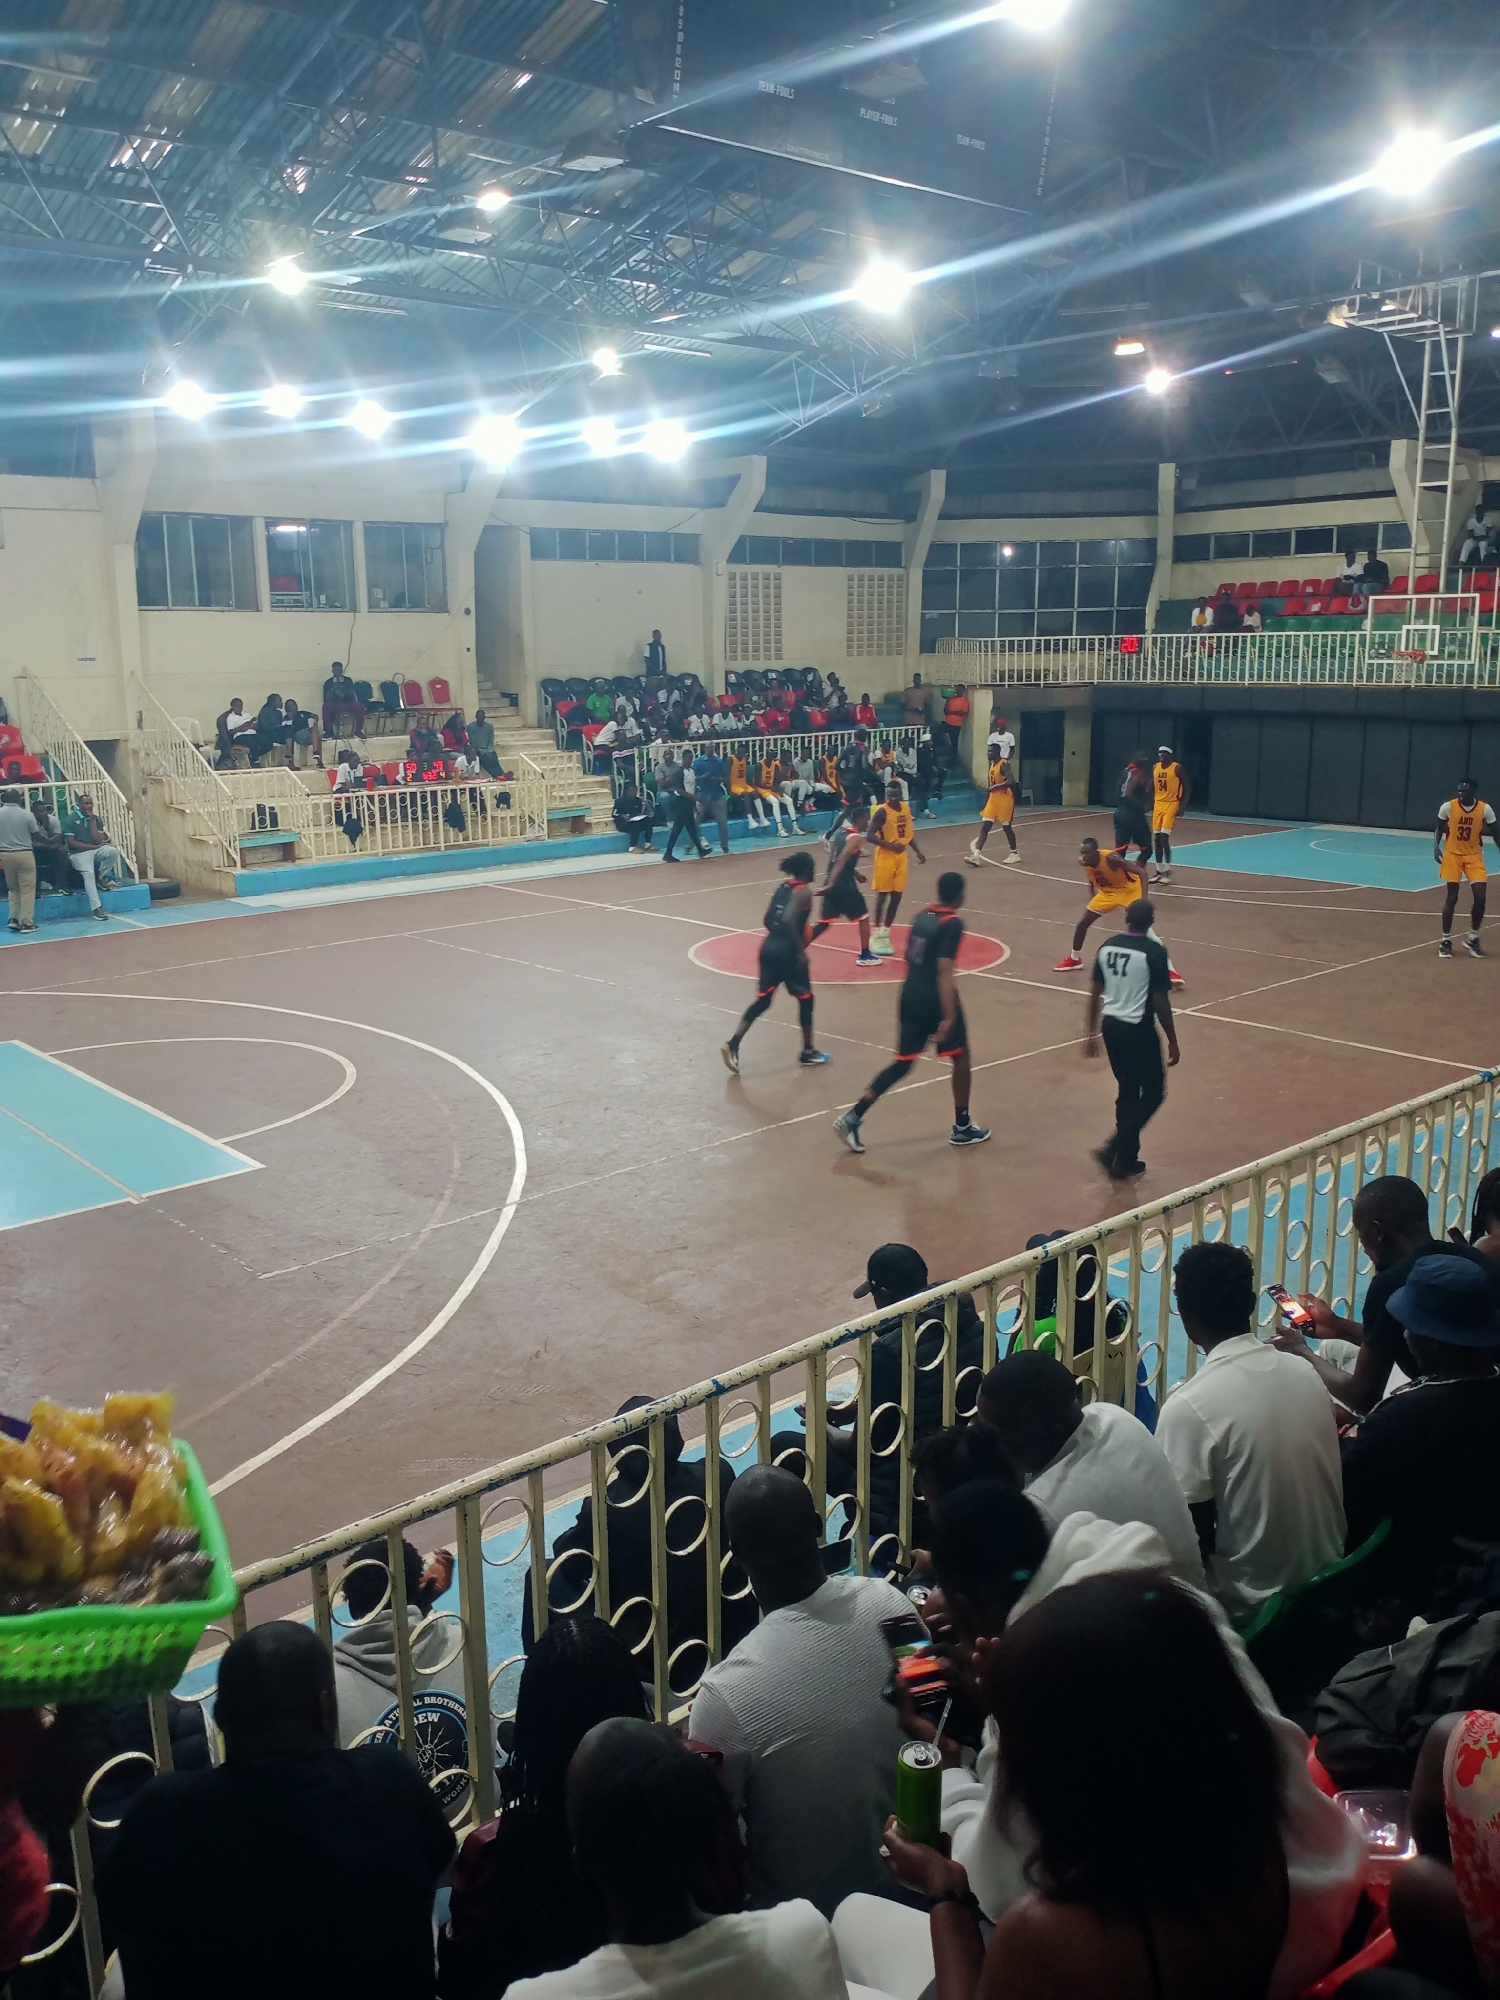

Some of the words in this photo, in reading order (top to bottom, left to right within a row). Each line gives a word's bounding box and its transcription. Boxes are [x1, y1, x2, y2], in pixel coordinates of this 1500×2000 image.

[1157, 779, 1168, 792] 34
[1458, 816, 1474, 825] ANU
[1457, 827, 1472, 841] 33
[1106, 951, 1131, 977] 47
